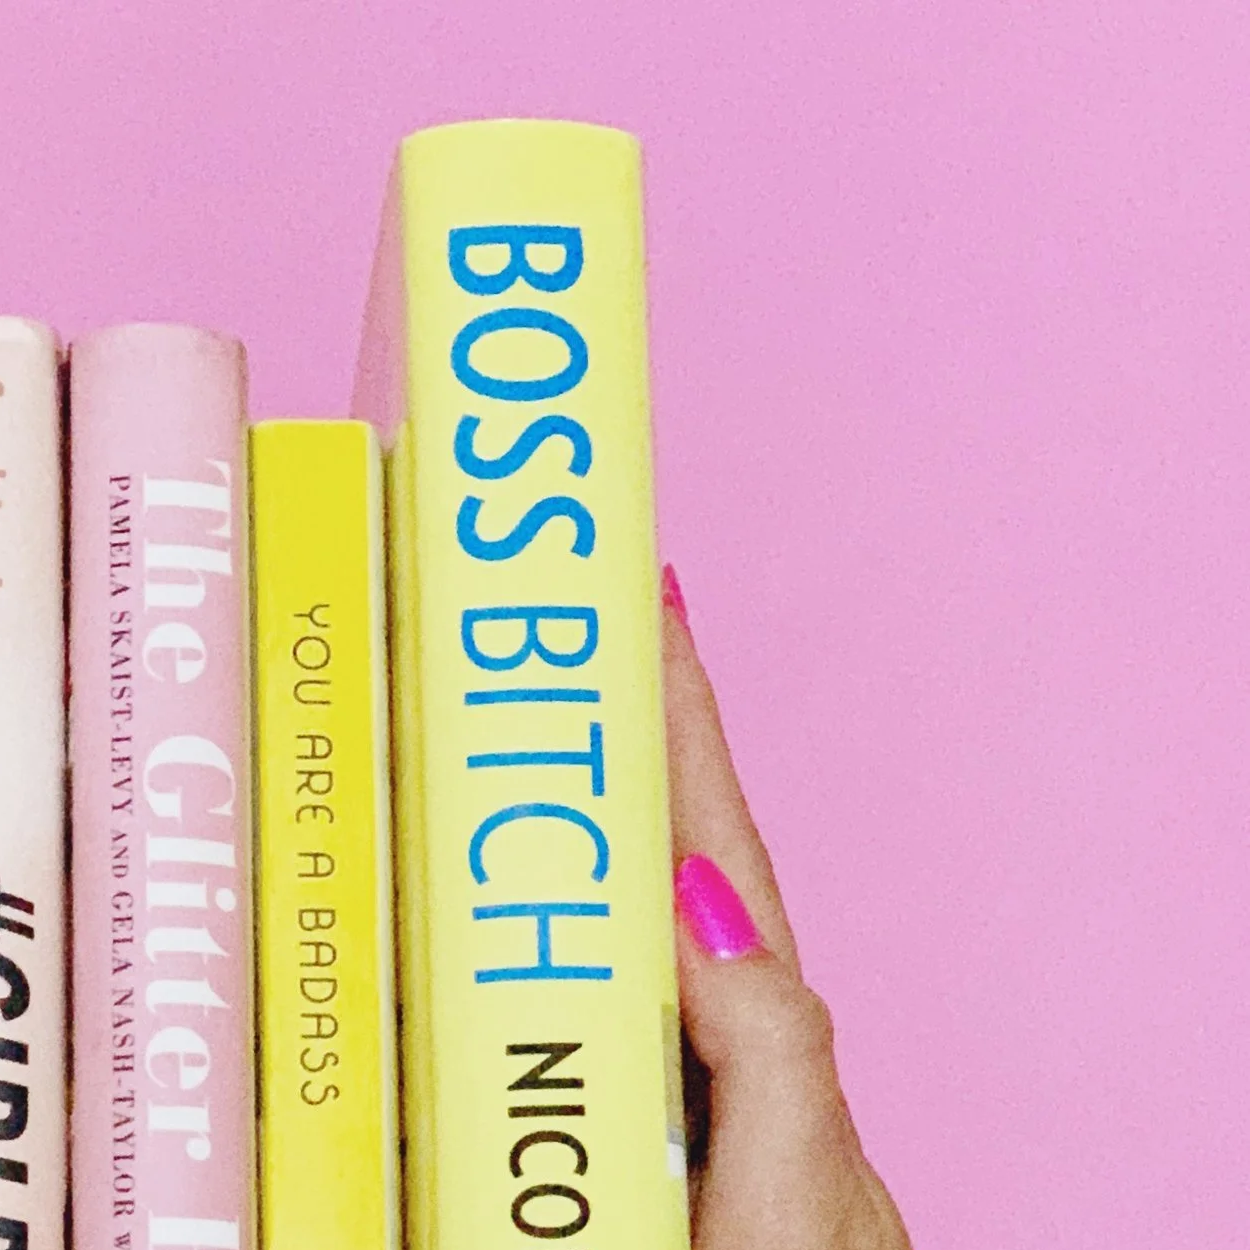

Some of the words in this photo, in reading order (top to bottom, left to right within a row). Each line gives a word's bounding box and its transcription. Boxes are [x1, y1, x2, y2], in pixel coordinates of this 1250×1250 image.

[448, 225, 596, 562] BOSS
[109, 475, 132, 597] PAMELA
[143, 459, 233, 684] The
[110, 610, 134, 815] SKAIST-LEVY
[292, 603, 332, 706] YOU
[110, 829, 130, 879] AND
[295, 733, 335, 825] ARE
[297, 852, 336, 879] A
[461, 606, 613, 984] BITCH
[111, 891, 135, 976] GELA
[143, 735, 237, 1161] Glitter
[298, 907, 341, 1106] BADASS
[112, 986, 136, 1218] NASH-TAYLOR
